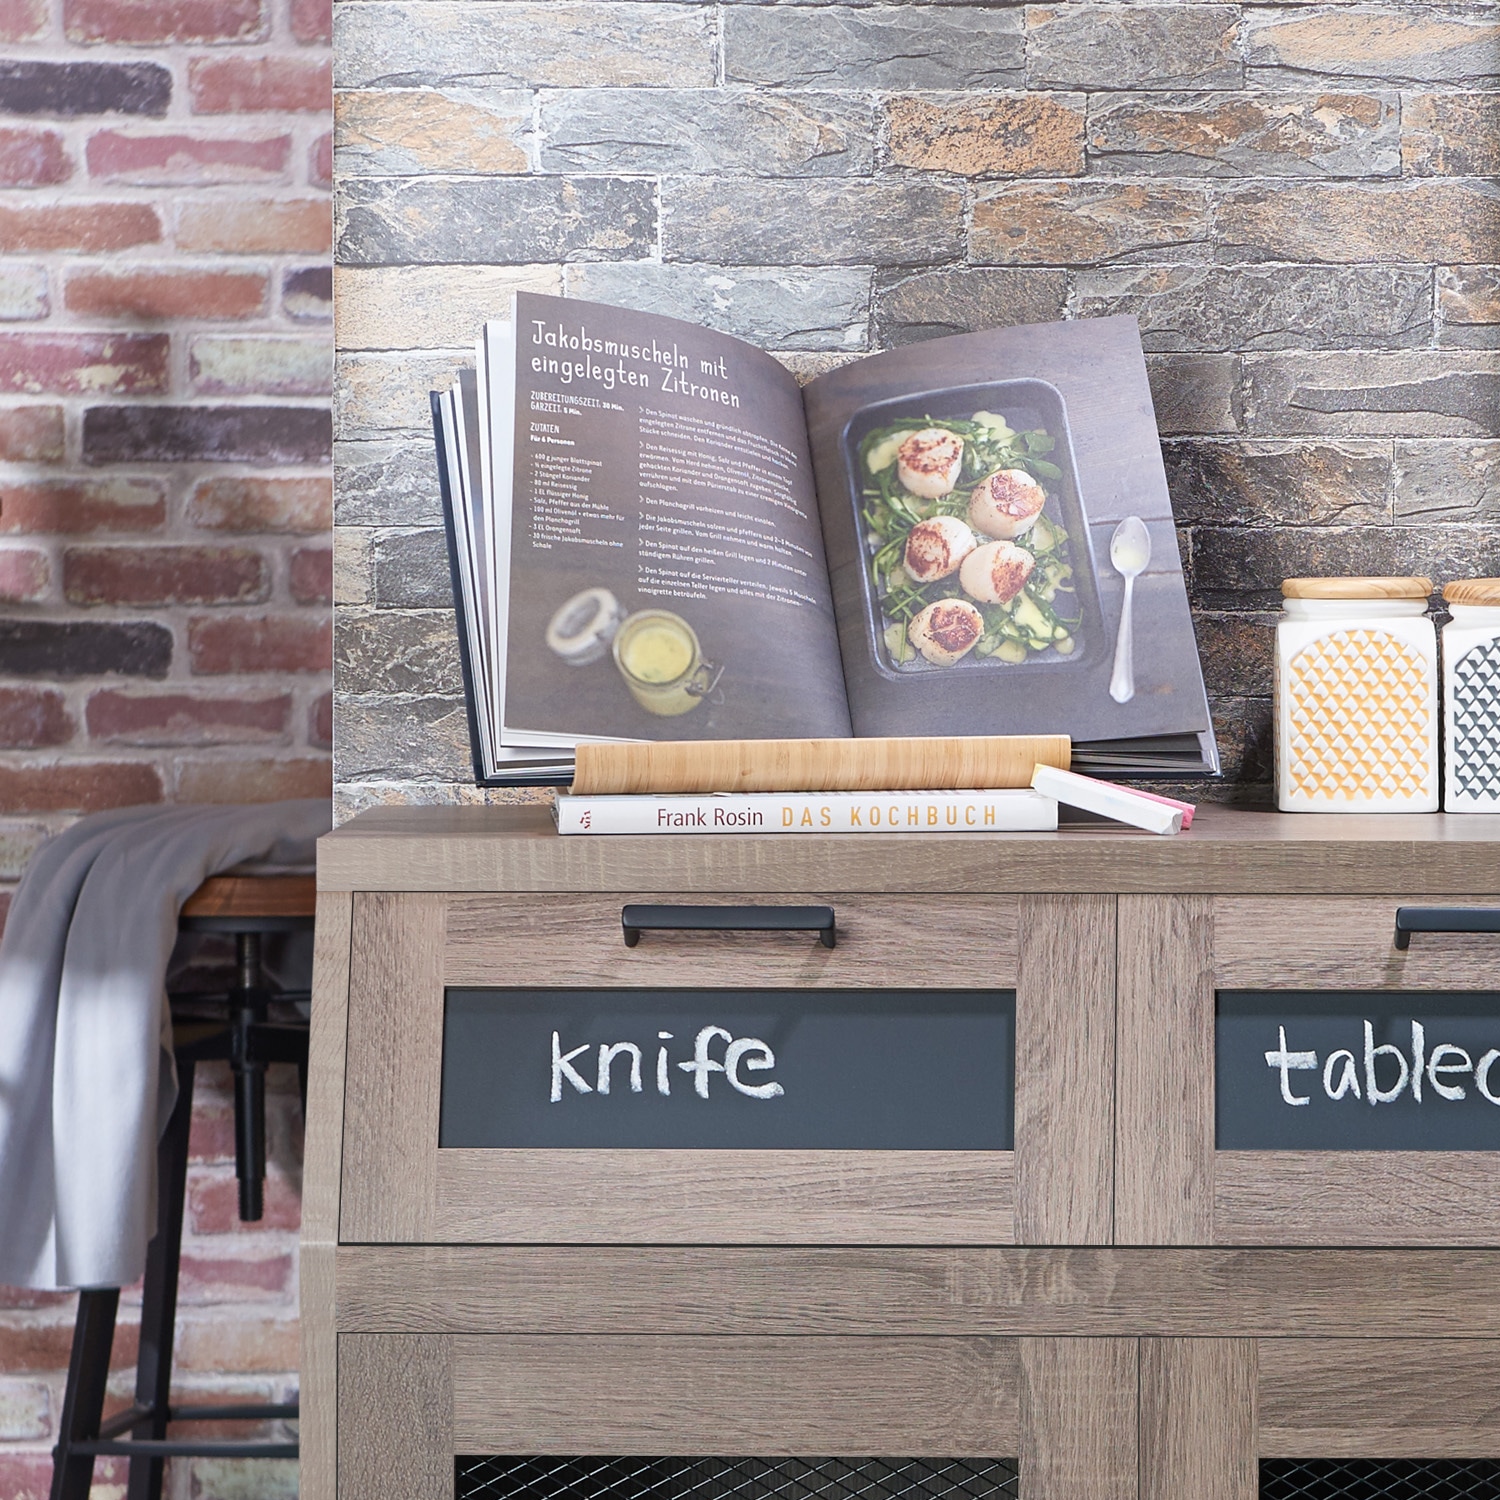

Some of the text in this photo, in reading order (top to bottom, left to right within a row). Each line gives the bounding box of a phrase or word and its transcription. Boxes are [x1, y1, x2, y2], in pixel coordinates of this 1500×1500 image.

[531, 320, 728, 379] Jakobsmuscheln mit
[531, 355, 739, 408] eingelegten Zitronen
[657, 806, 995, 827] Frank Rosin DAS KOCHBUCH
[549, 1024, 785, 1103] knife
